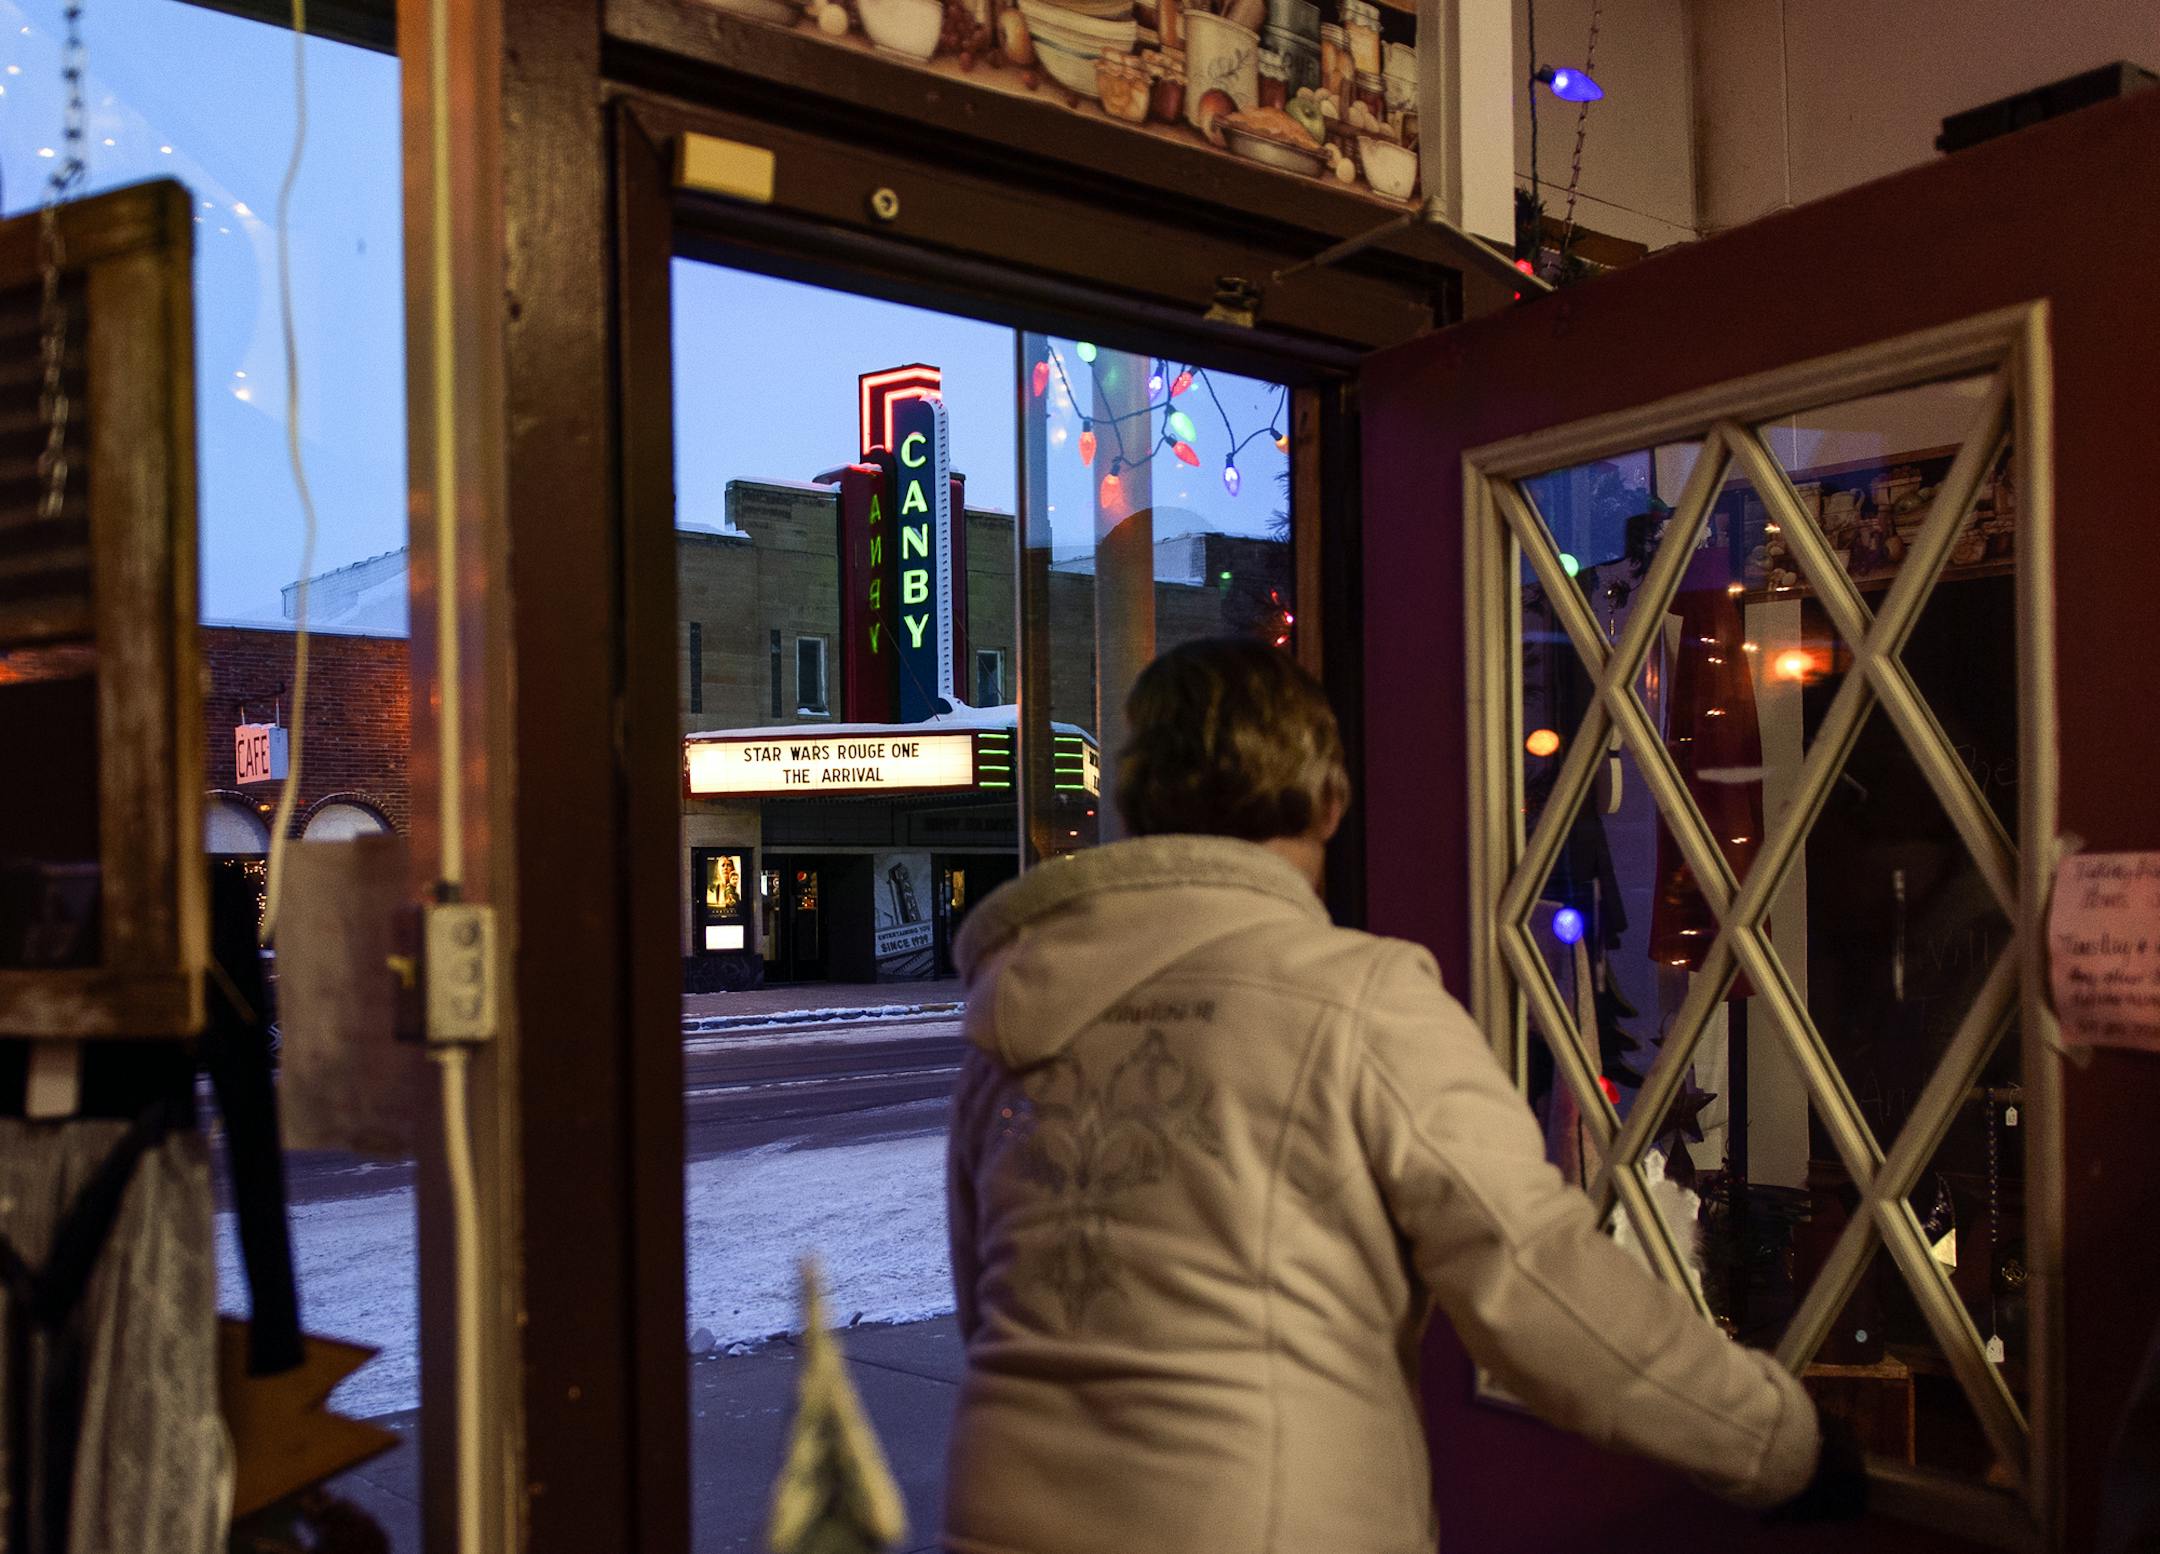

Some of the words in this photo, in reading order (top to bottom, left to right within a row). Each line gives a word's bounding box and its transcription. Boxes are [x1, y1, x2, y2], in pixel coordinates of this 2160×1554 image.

[901, 433, 930, 648] CANBY
[238, 735, 269, 778] CAFE
[744, 747, 781, 762] STAR
[790, 745, 829, 761] WARS
[838, 743, 885, 759] ROUGE
[891, 742, 919, 758] ONE
[783, 769, 810, 784] THE
[822, 767, 884, 783] ARRIVAL
[881, 938, 909, 953] SINCE
